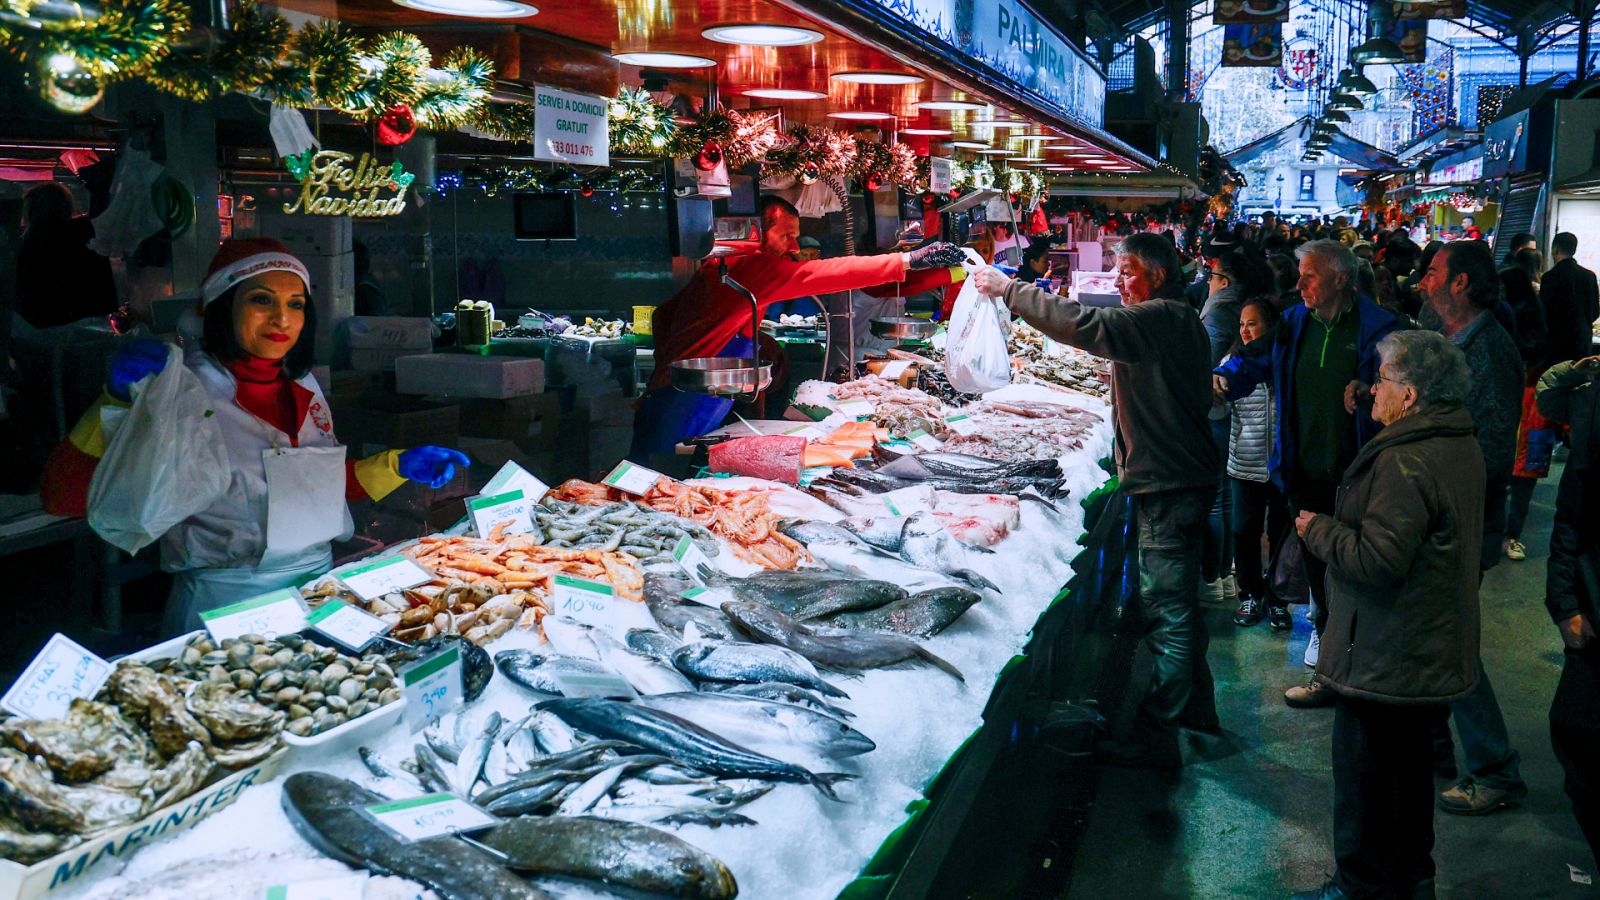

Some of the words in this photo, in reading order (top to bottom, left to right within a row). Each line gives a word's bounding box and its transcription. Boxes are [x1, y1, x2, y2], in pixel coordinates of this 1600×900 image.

[998, 3, 1065, 83] PALMIRA
[537, 94, 563, 109] SERVEI
[565, 100, 571, 111] A
[572, 101, 604, 116] DOMICILI
[556, 119, 588, 134] GRATUIT
[565, 143, 579, 155] 011
[580, 145, 593, 157] 476
[311, 150, 393, 191] Feliz
[283, 183, 407, 217] Navidad
[49, 768, 261, 889] MARINTER
